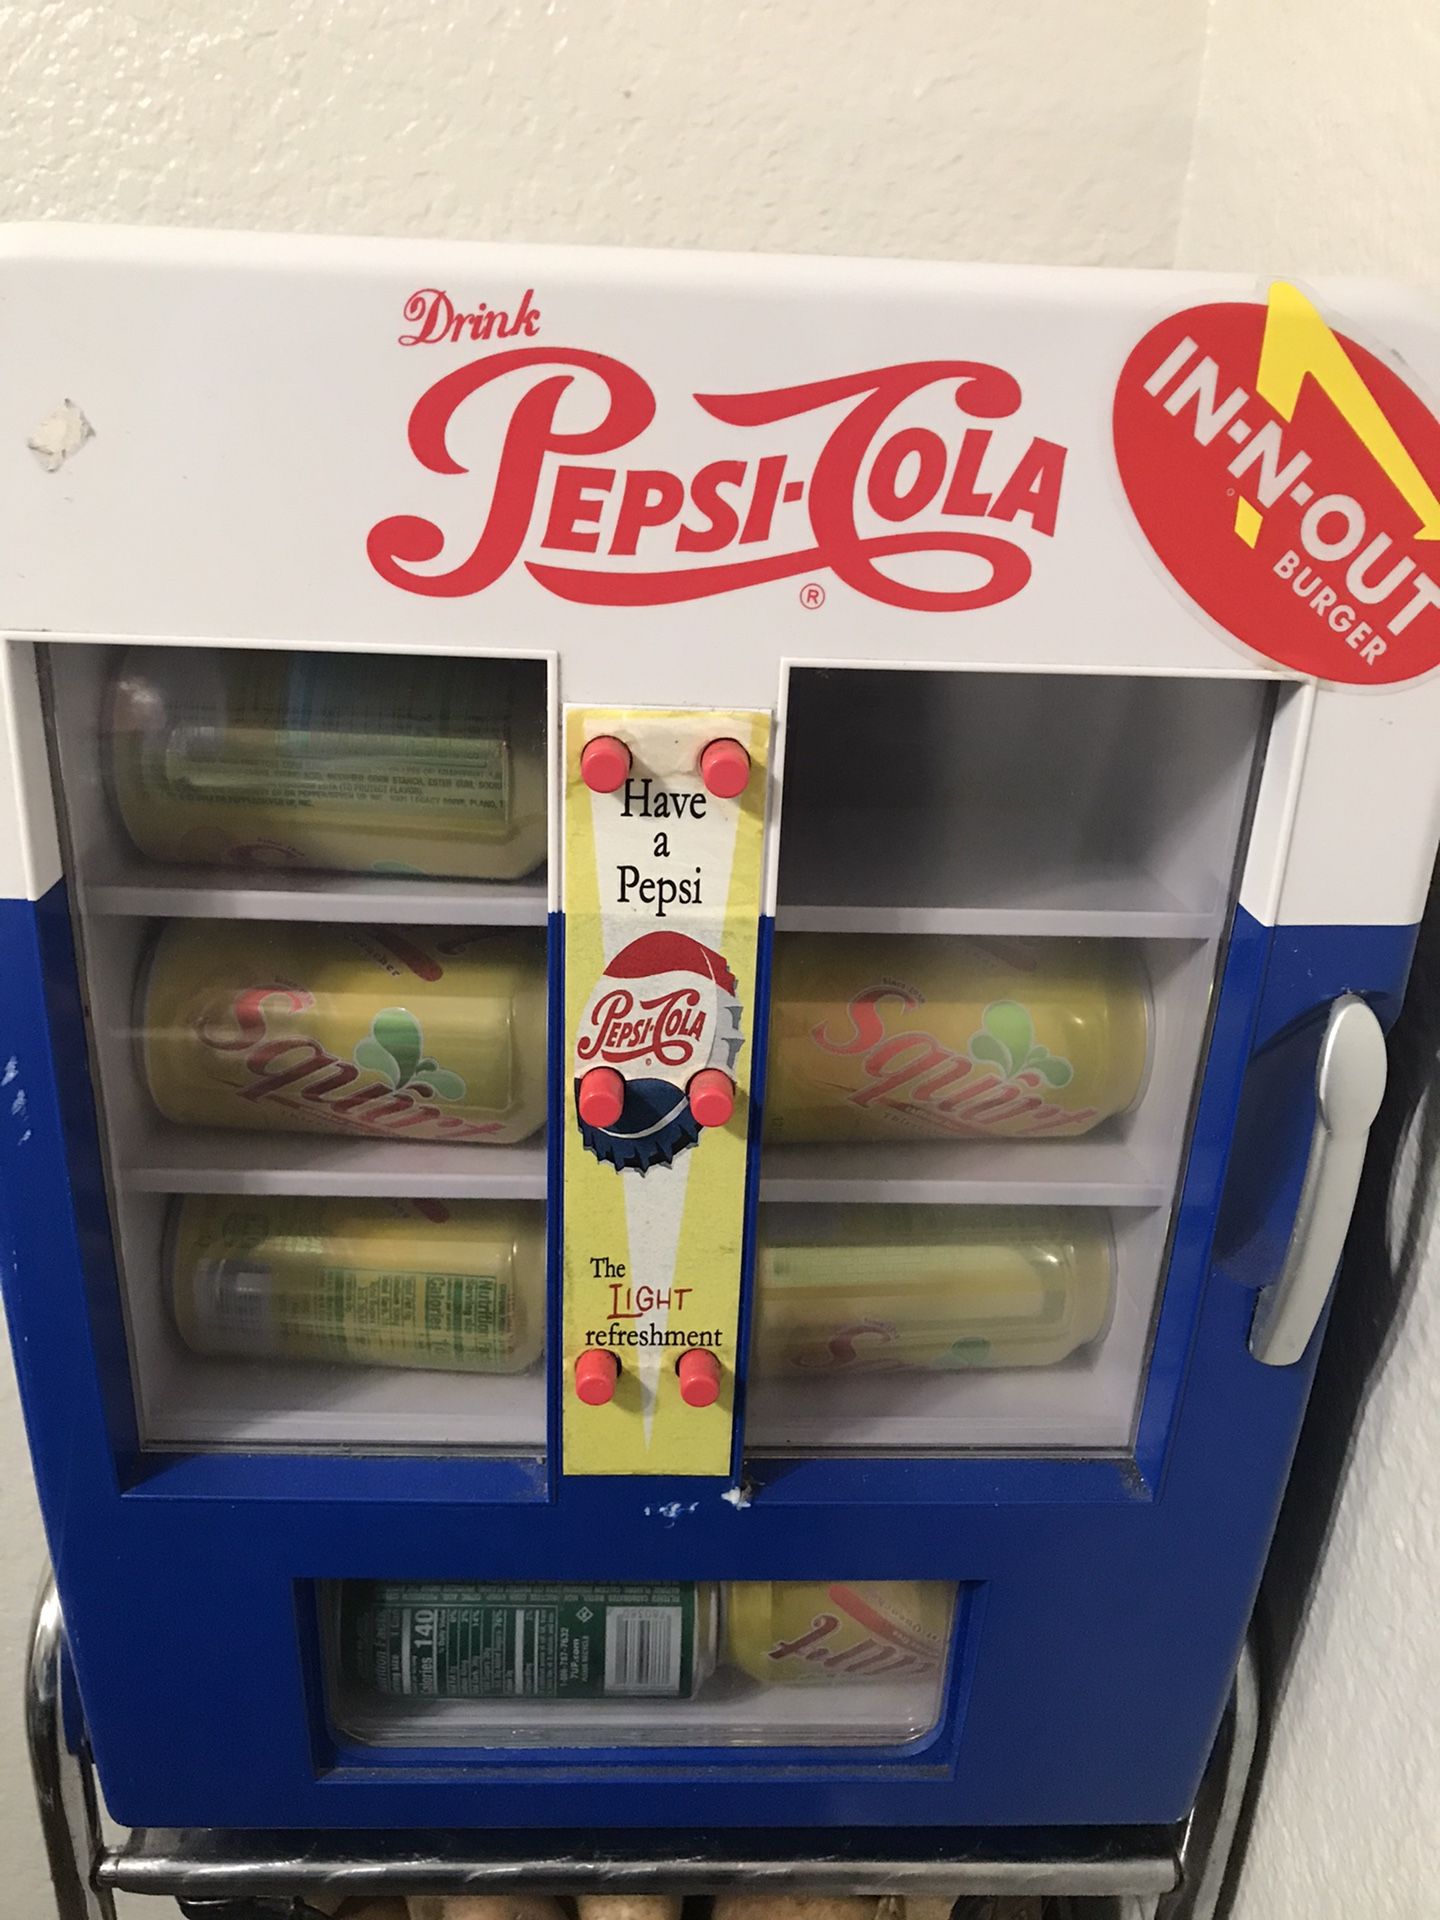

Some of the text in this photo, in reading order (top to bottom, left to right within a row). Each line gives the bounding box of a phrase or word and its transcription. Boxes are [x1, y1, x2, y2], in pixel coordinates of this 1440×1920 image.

[398, 288, 541, 346] Drink
[1143, 335, 1440, 636] IN-N-OUT
[1273, 549, 1387, 666] BURGER
[620, 777, 707, 820] Have
[653, 831, 670, 857] a
[617, 865, 703, 917] Pepsi
[590, 1257, 626, 1279] The
[607, 1283, 693, 1320] LIGHT
[585, 1322, 723, 1348] refreshment
[414, 1609, 434, 1649] 140
[569, 1638, 580, 1680] 7UP.com
